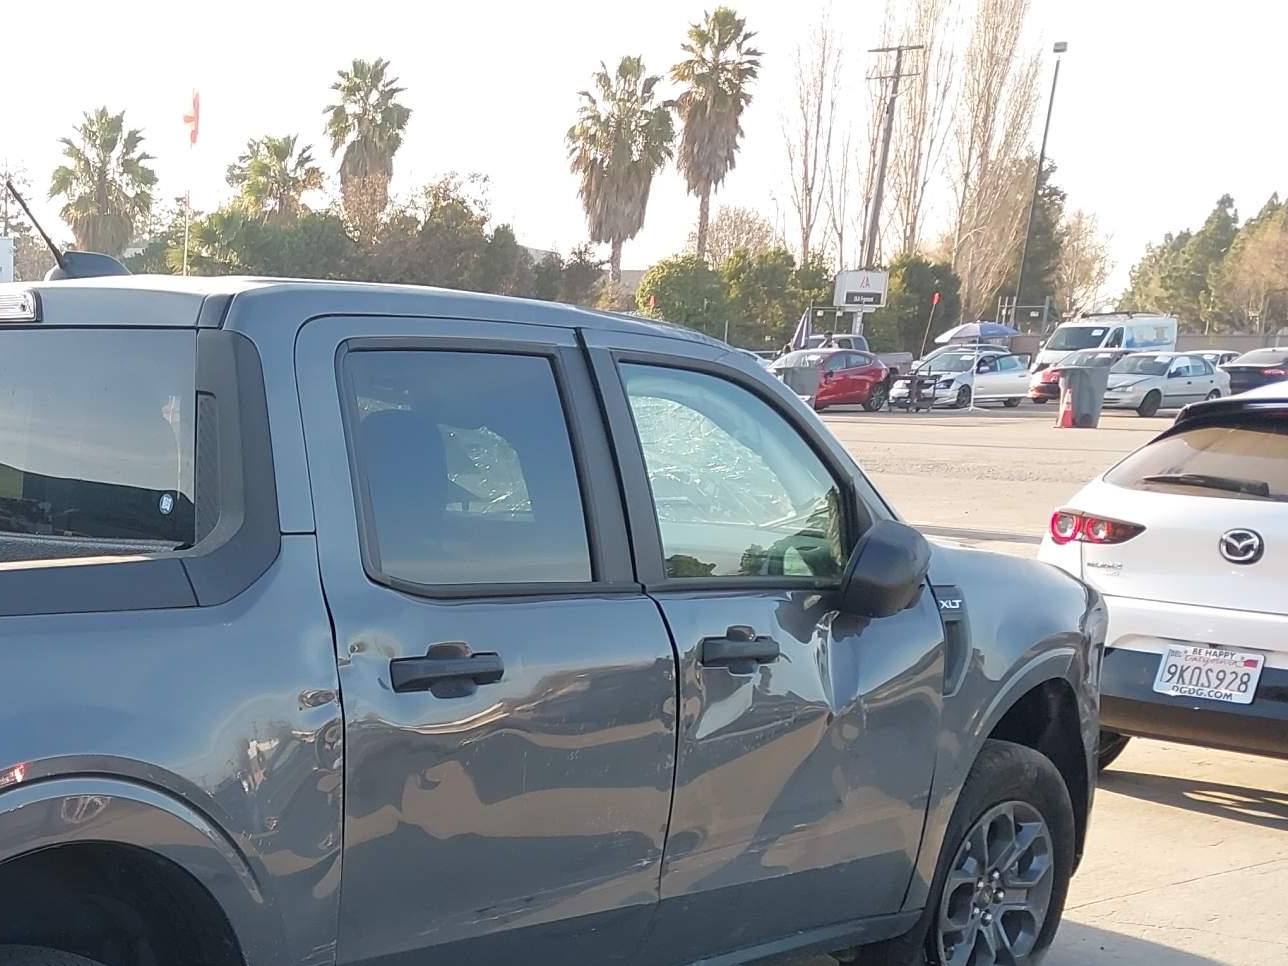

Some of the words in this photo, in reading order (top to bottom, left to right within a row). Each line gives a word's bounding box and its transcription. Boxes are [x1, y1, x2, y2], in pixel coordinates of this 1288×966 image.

[939, 599, 962, 609] XLT
[1192, 648, 1202, 656] BE
[1205, 649, 1237, 659] HAPPY
